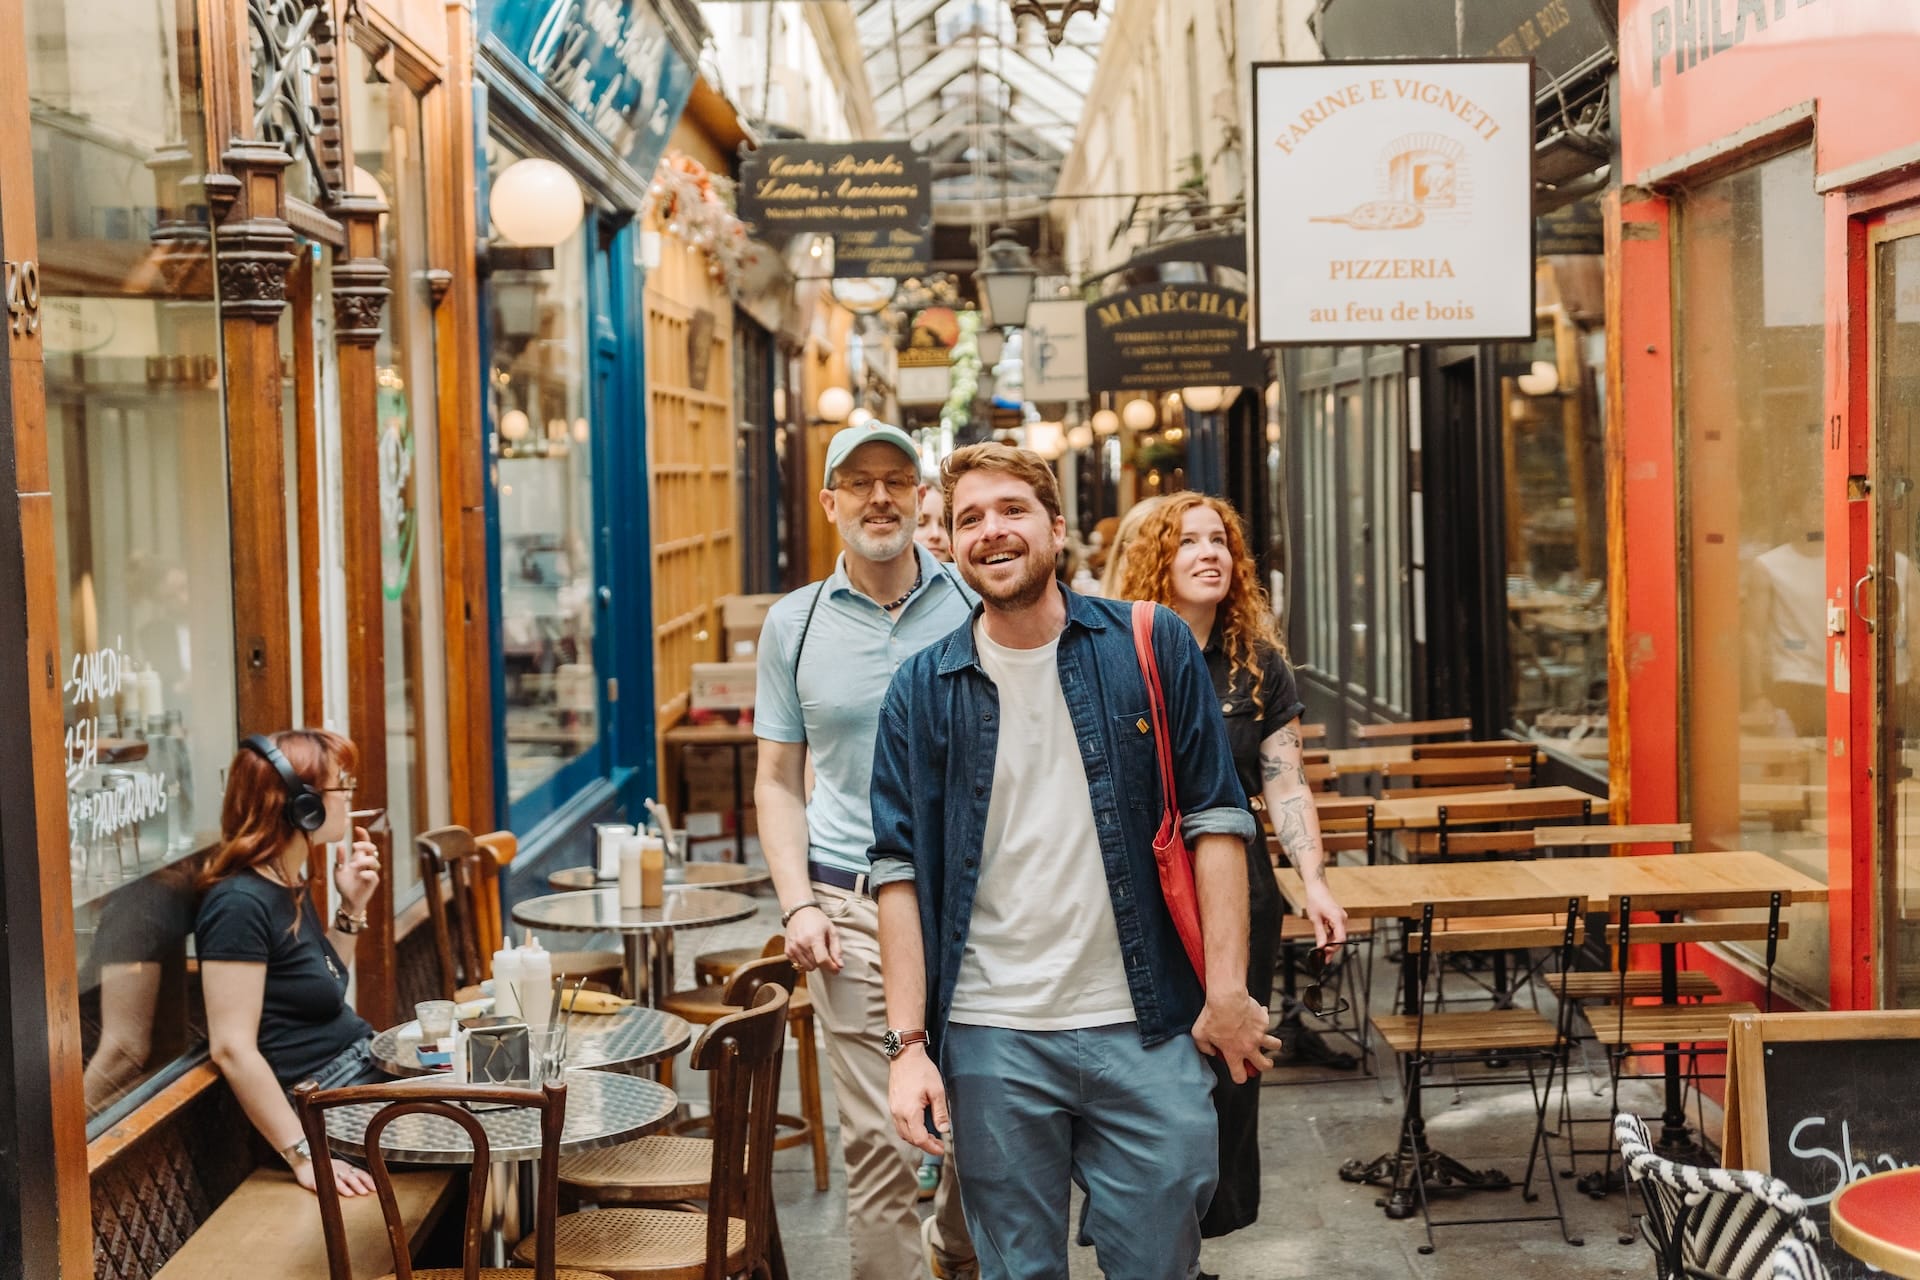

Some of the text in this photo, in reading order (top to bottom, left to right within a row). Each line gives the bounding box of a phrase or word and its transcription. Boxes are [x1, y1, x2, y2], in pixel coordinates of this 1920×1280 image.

[1536, 0, 1570, 38] BOIS
[1651, 0, 1816, 88] PHILA
[1274, 79, 1502, 155] FARINE E VIGNETI
[7, 261, 40, 336] 49
[1329, 257, 1456, 280] PIZZERIA
[1309, 299, 1476, 322] au feu de bois
[1788, 1116, 1909, 1206] Sh
